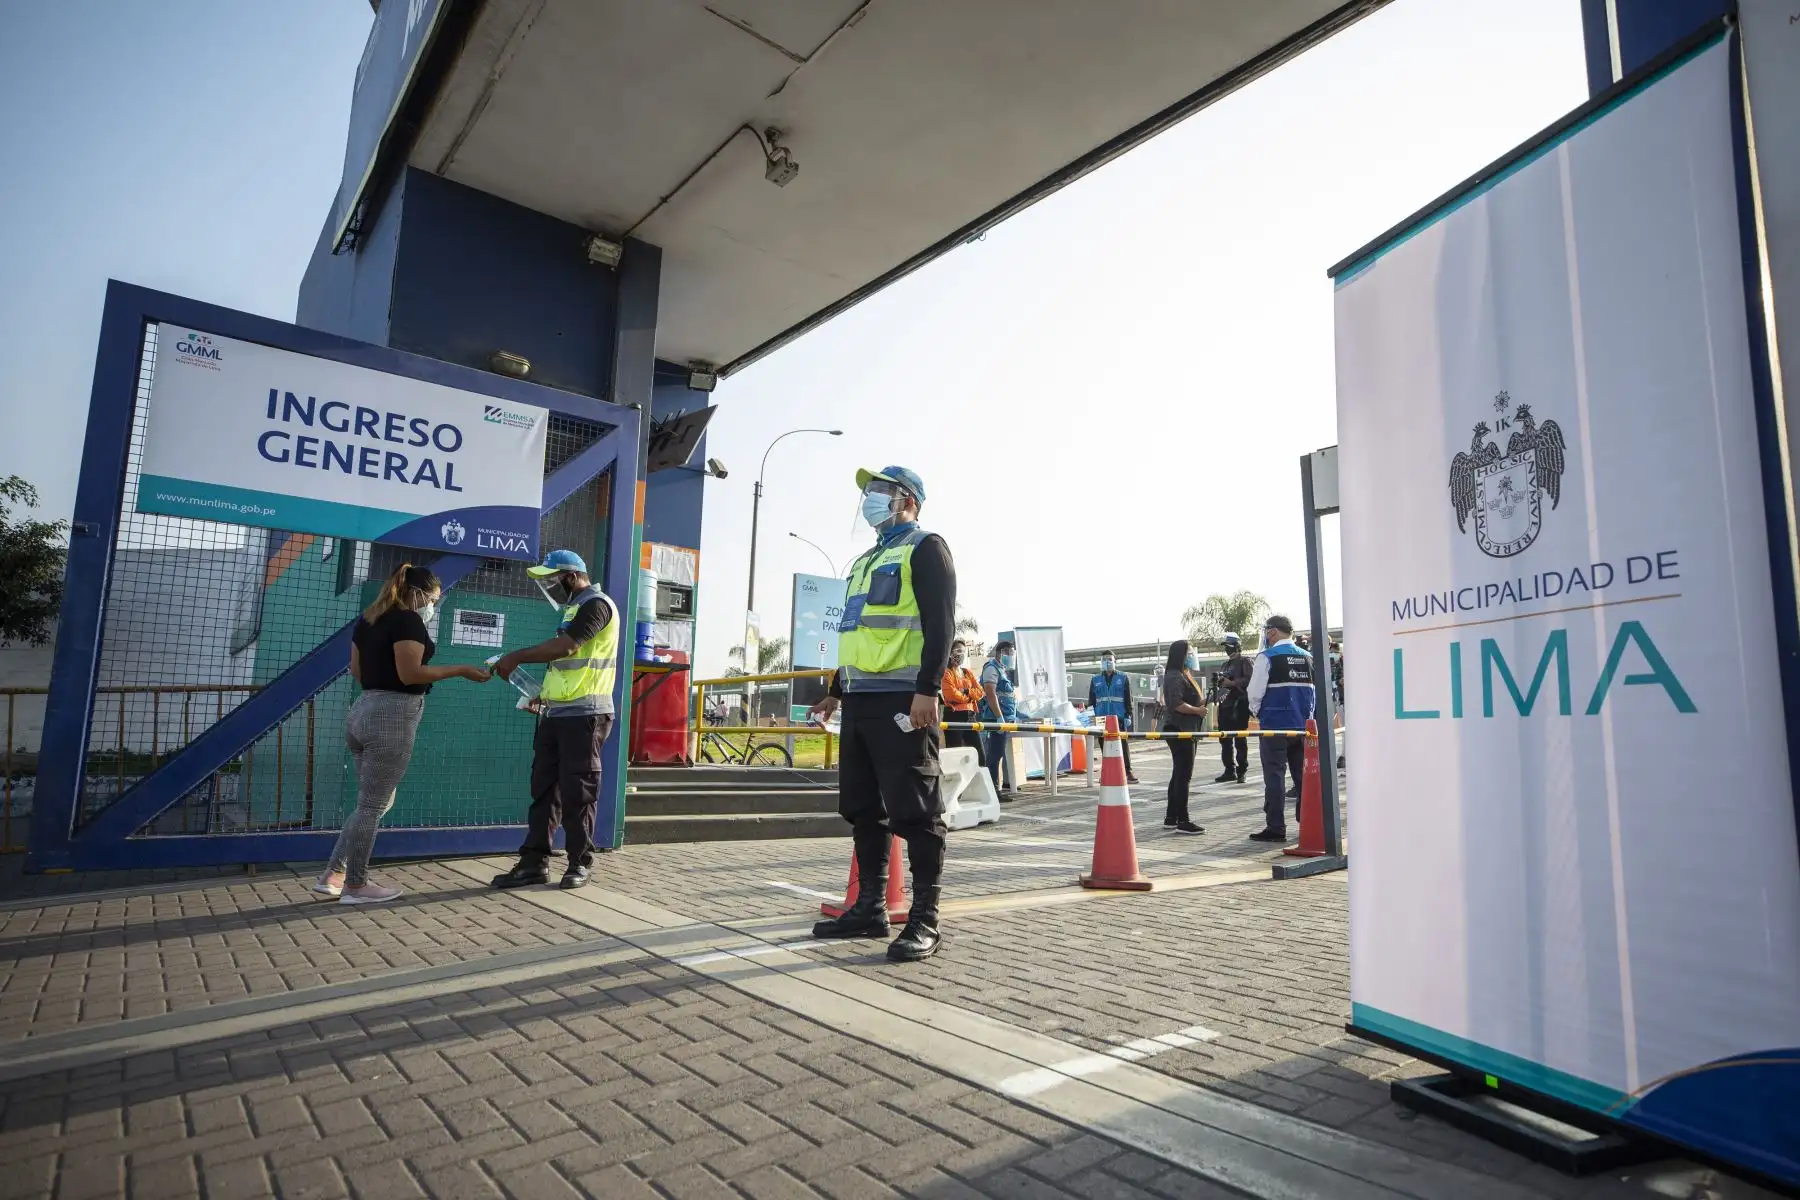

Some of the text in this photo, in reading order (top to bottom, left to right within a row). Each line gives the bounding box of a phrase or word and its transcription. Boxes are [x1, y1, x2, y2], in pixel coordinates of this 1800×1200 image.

[175, 341, 223, 361] GMML
[266, 388, 463, 452] INGRESO
[503, 411, 535, 424] EMMSA
[257, 430, 463, 492] GENERAL
[156, 492, 276, 516] www.munlima.gob.pe
[477, 534, 530, 554] LIMA
[1392, 550, 1681, 621] MUNICIPALIDAD DE
[820, 643, 825, 651] E
[1393, 620, 1699, 720] LIMA
